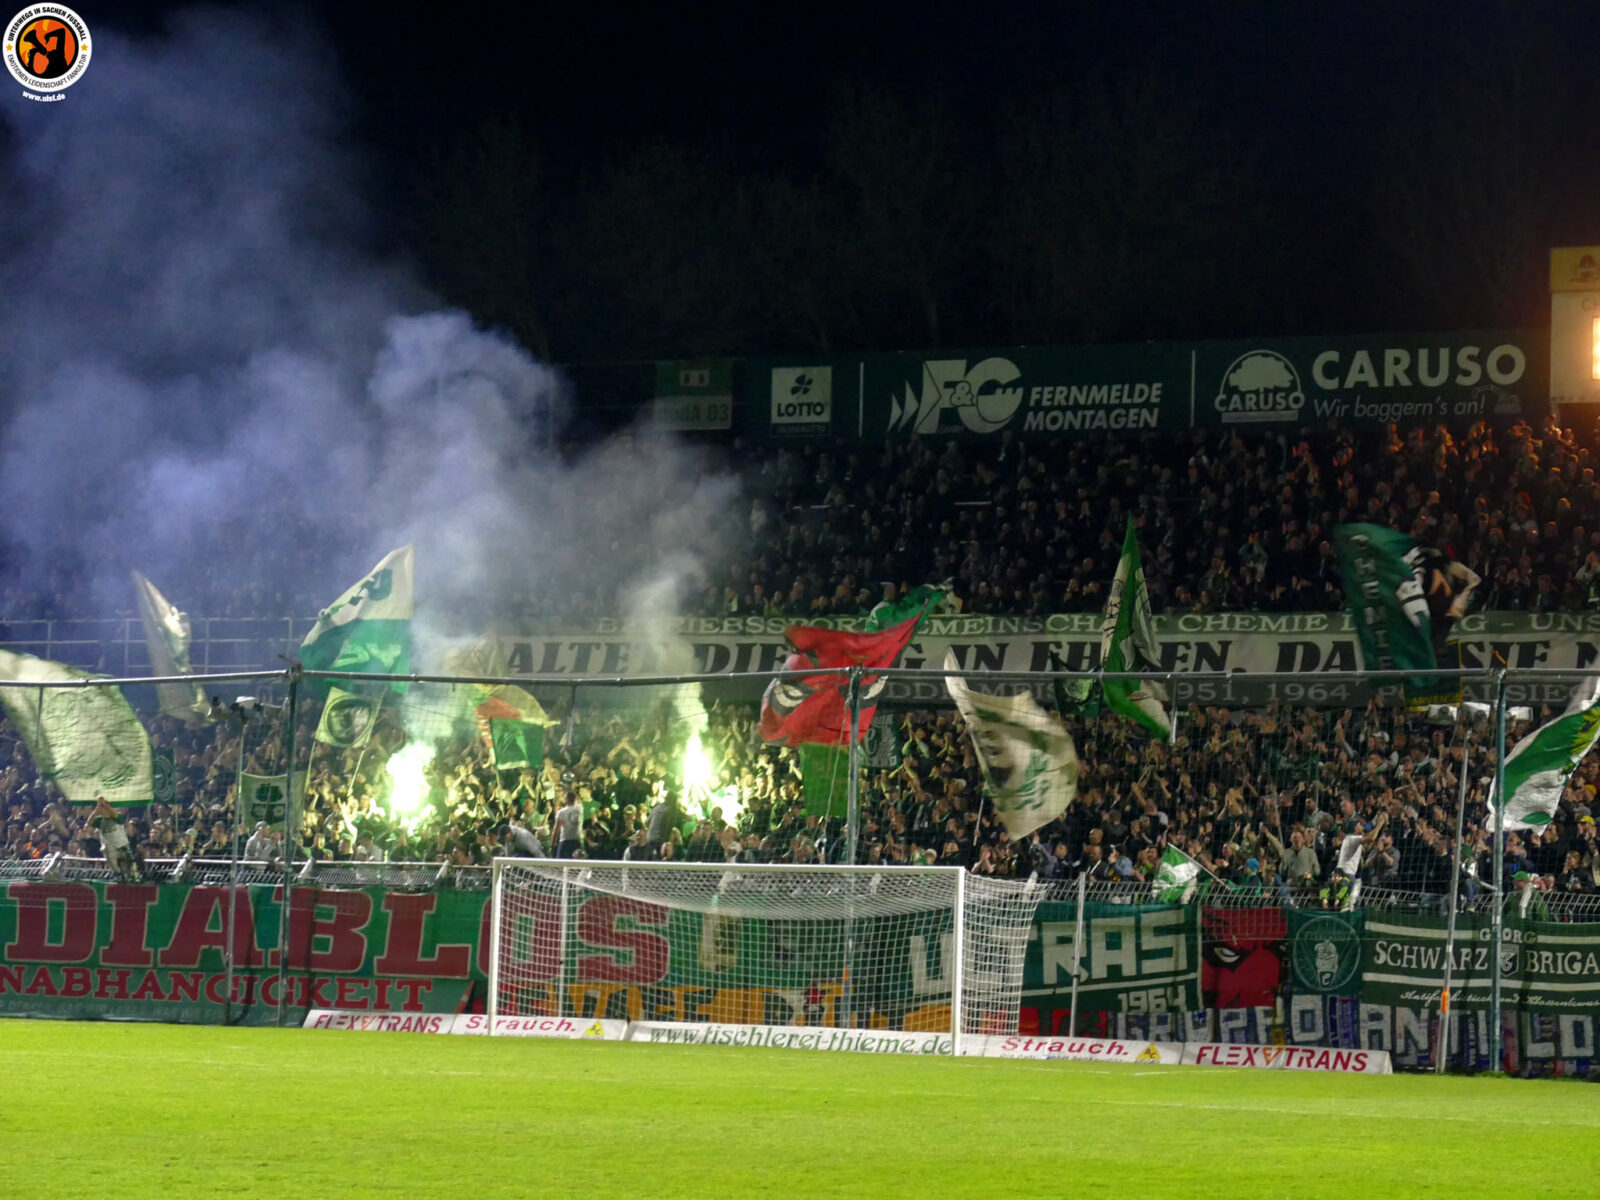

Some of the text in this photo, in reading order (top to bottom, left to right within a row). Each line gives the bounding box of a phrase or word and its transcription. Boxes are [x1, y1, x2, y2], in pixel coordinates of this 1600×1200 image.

[1311, 344, 1527, 390] CARUSO
[1028, 381, 1164, 406] FERNMELDE
[1214, 391, 1306, 413] CARUSO
[776, 402, 826, 417] LOTTO
[1023, 407, 1159, 431] MONTAGEN
[1314, 399, 1350, 418] Wir
[1354, 397, 1449, 423] baggern's
[1453, 396, 1486, 416] an!
[1178, 613, 1328, 633] CHEMIE
[957, 643, 1010, 671] IN
[1176, 681, 1251, 704] 951,
[4, 880, 670, 986] DIABLOS
[1479, 927, 1537, 945] GORG
[1373, 940, 1489, 971] SCHWARZ
[1117, 984, 1187, 1014] 1964
[650, 1025, 952, 1055] www.tischlerei-thieme.de
[1001, 1037, 1129, 1056] Strauch.
